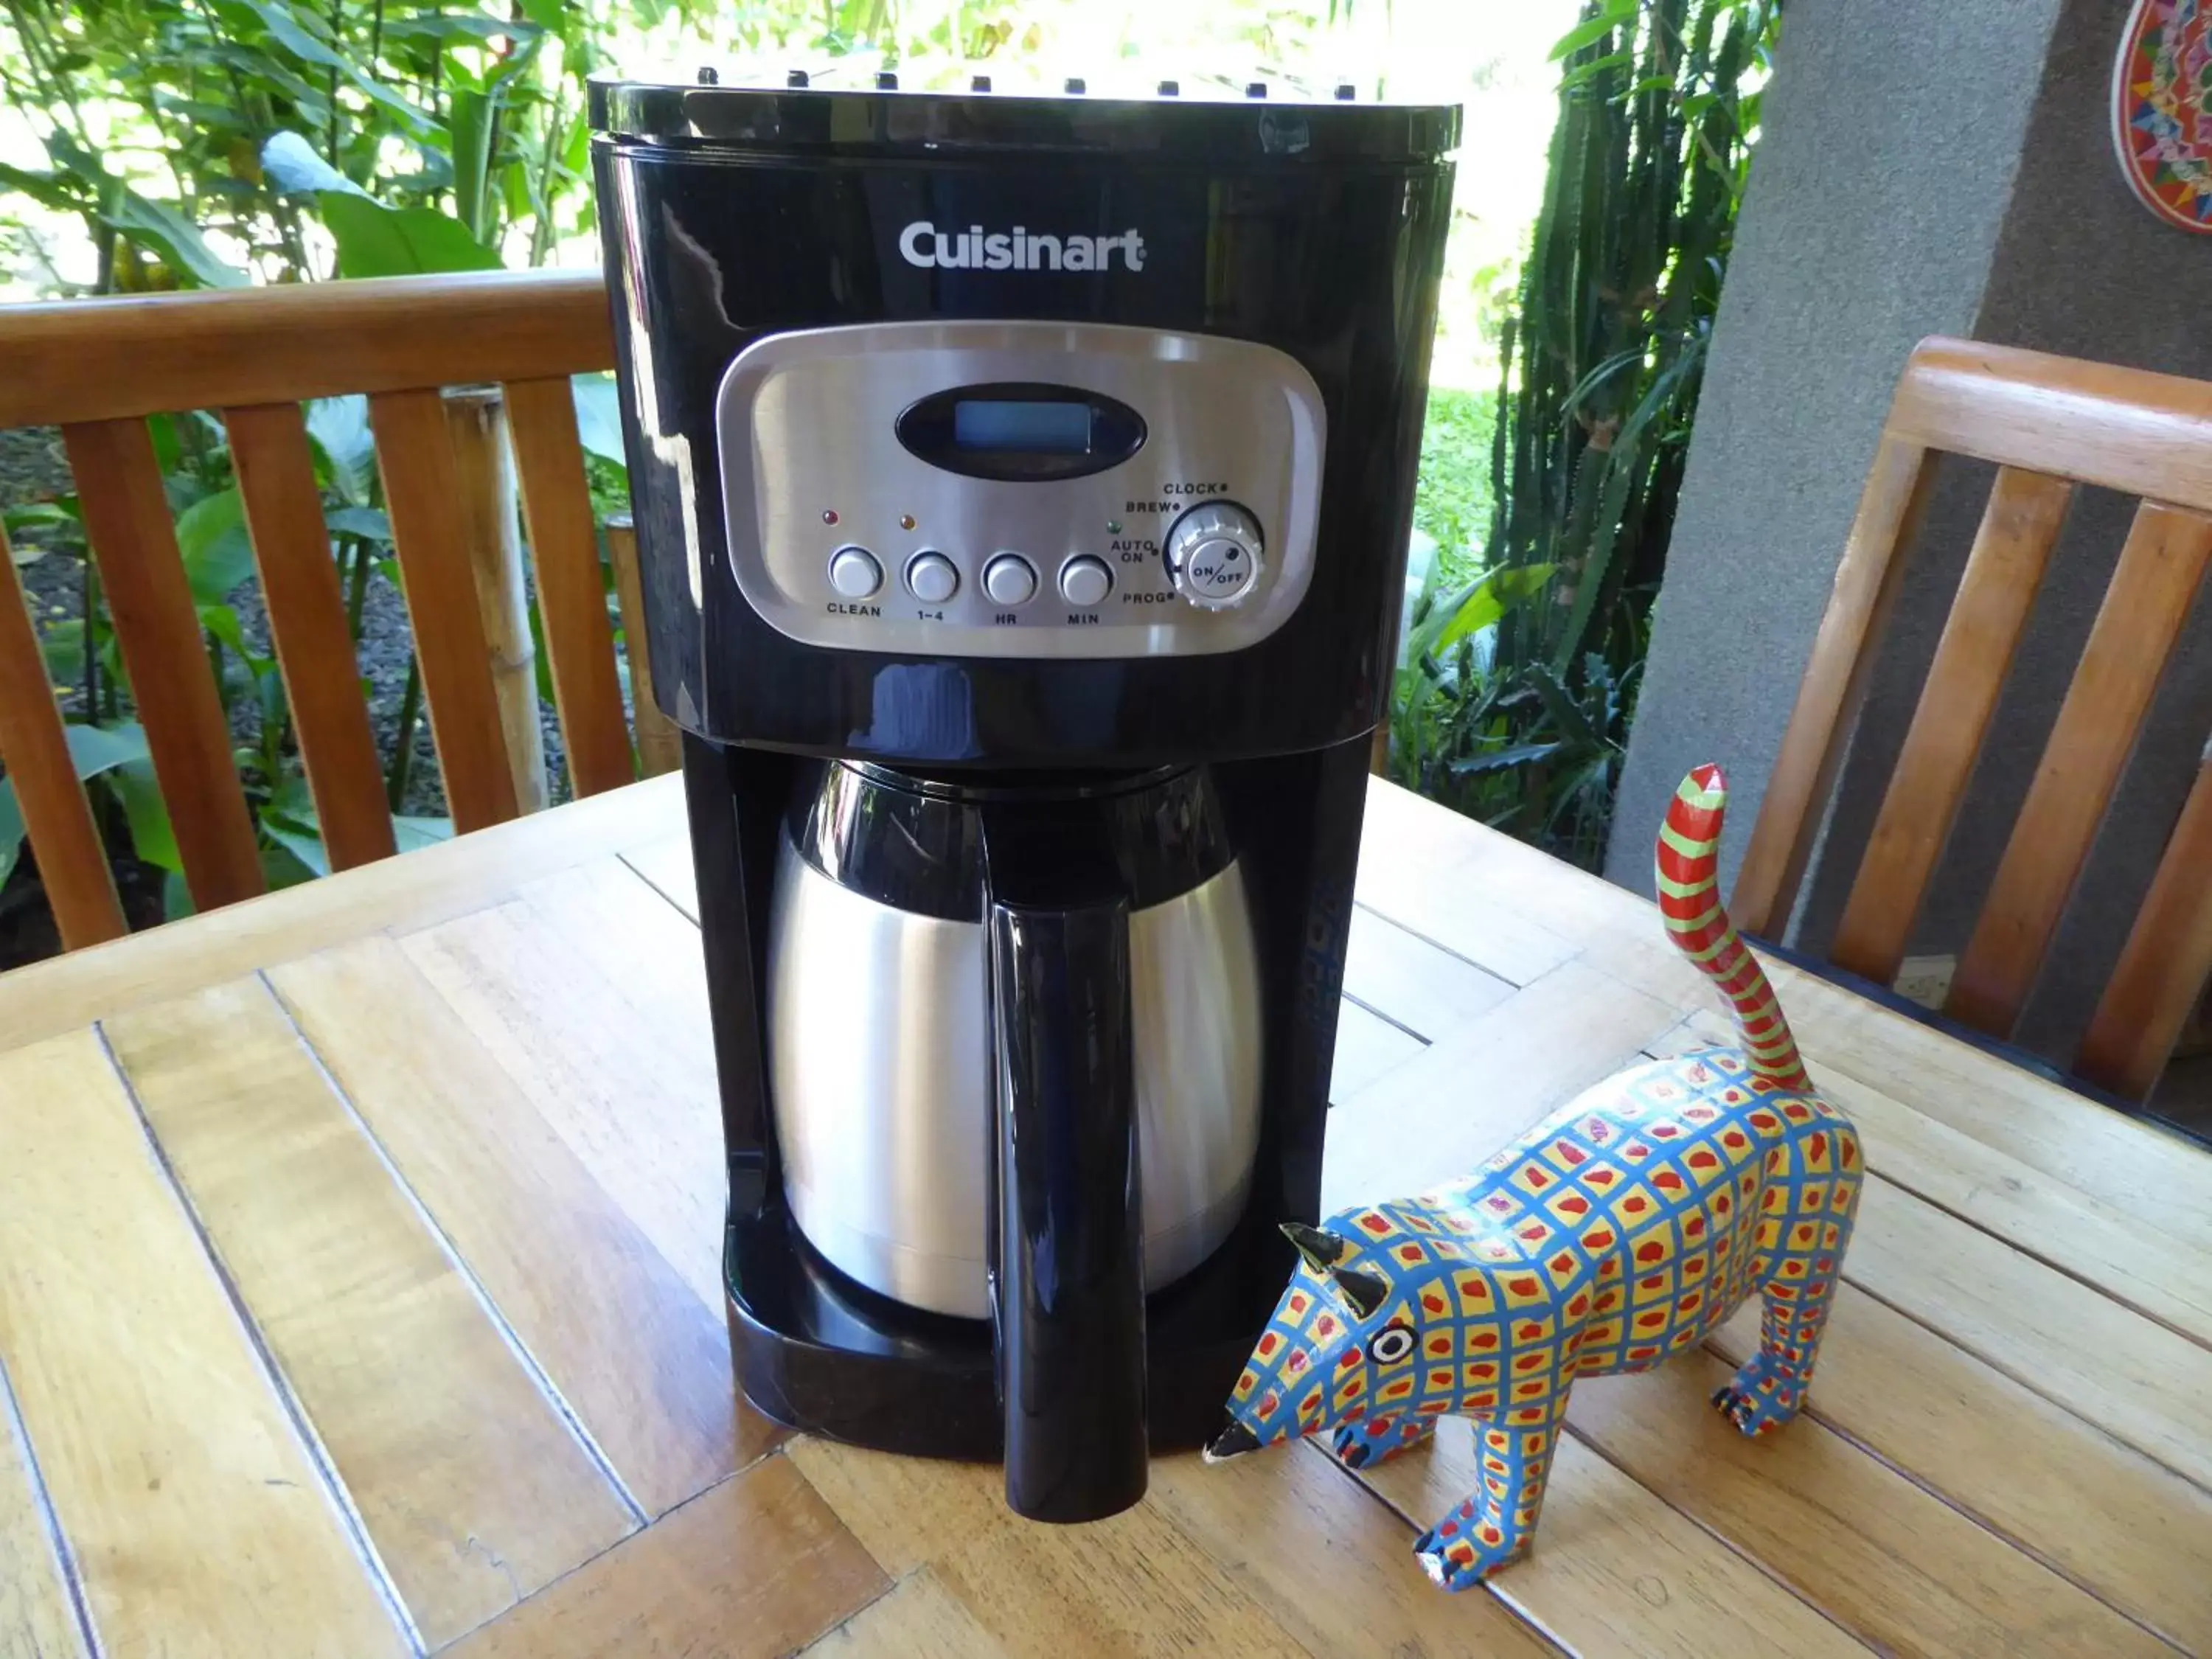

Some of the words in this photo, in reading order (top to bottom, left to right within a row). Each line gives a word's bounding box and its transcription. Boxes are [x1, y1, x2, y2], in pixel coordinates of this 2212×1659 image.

[899, 221, 1144, 271] Cuisinart
[1164, 483, 1217, 494] CLOCK
[1126, 501, 1172, 512] BREW
[1111, 540, 1154, 552] AUTO
[1121, 553, 1144, 563] ON
[1123, 591, 1166, 604] PROG
[827, 602, 881, 617] CLEAN
[917, 610, 944, 622] 1-4
[995, 613, 1017, 625] HR
[1068, 613, 1099, 625] MIN
